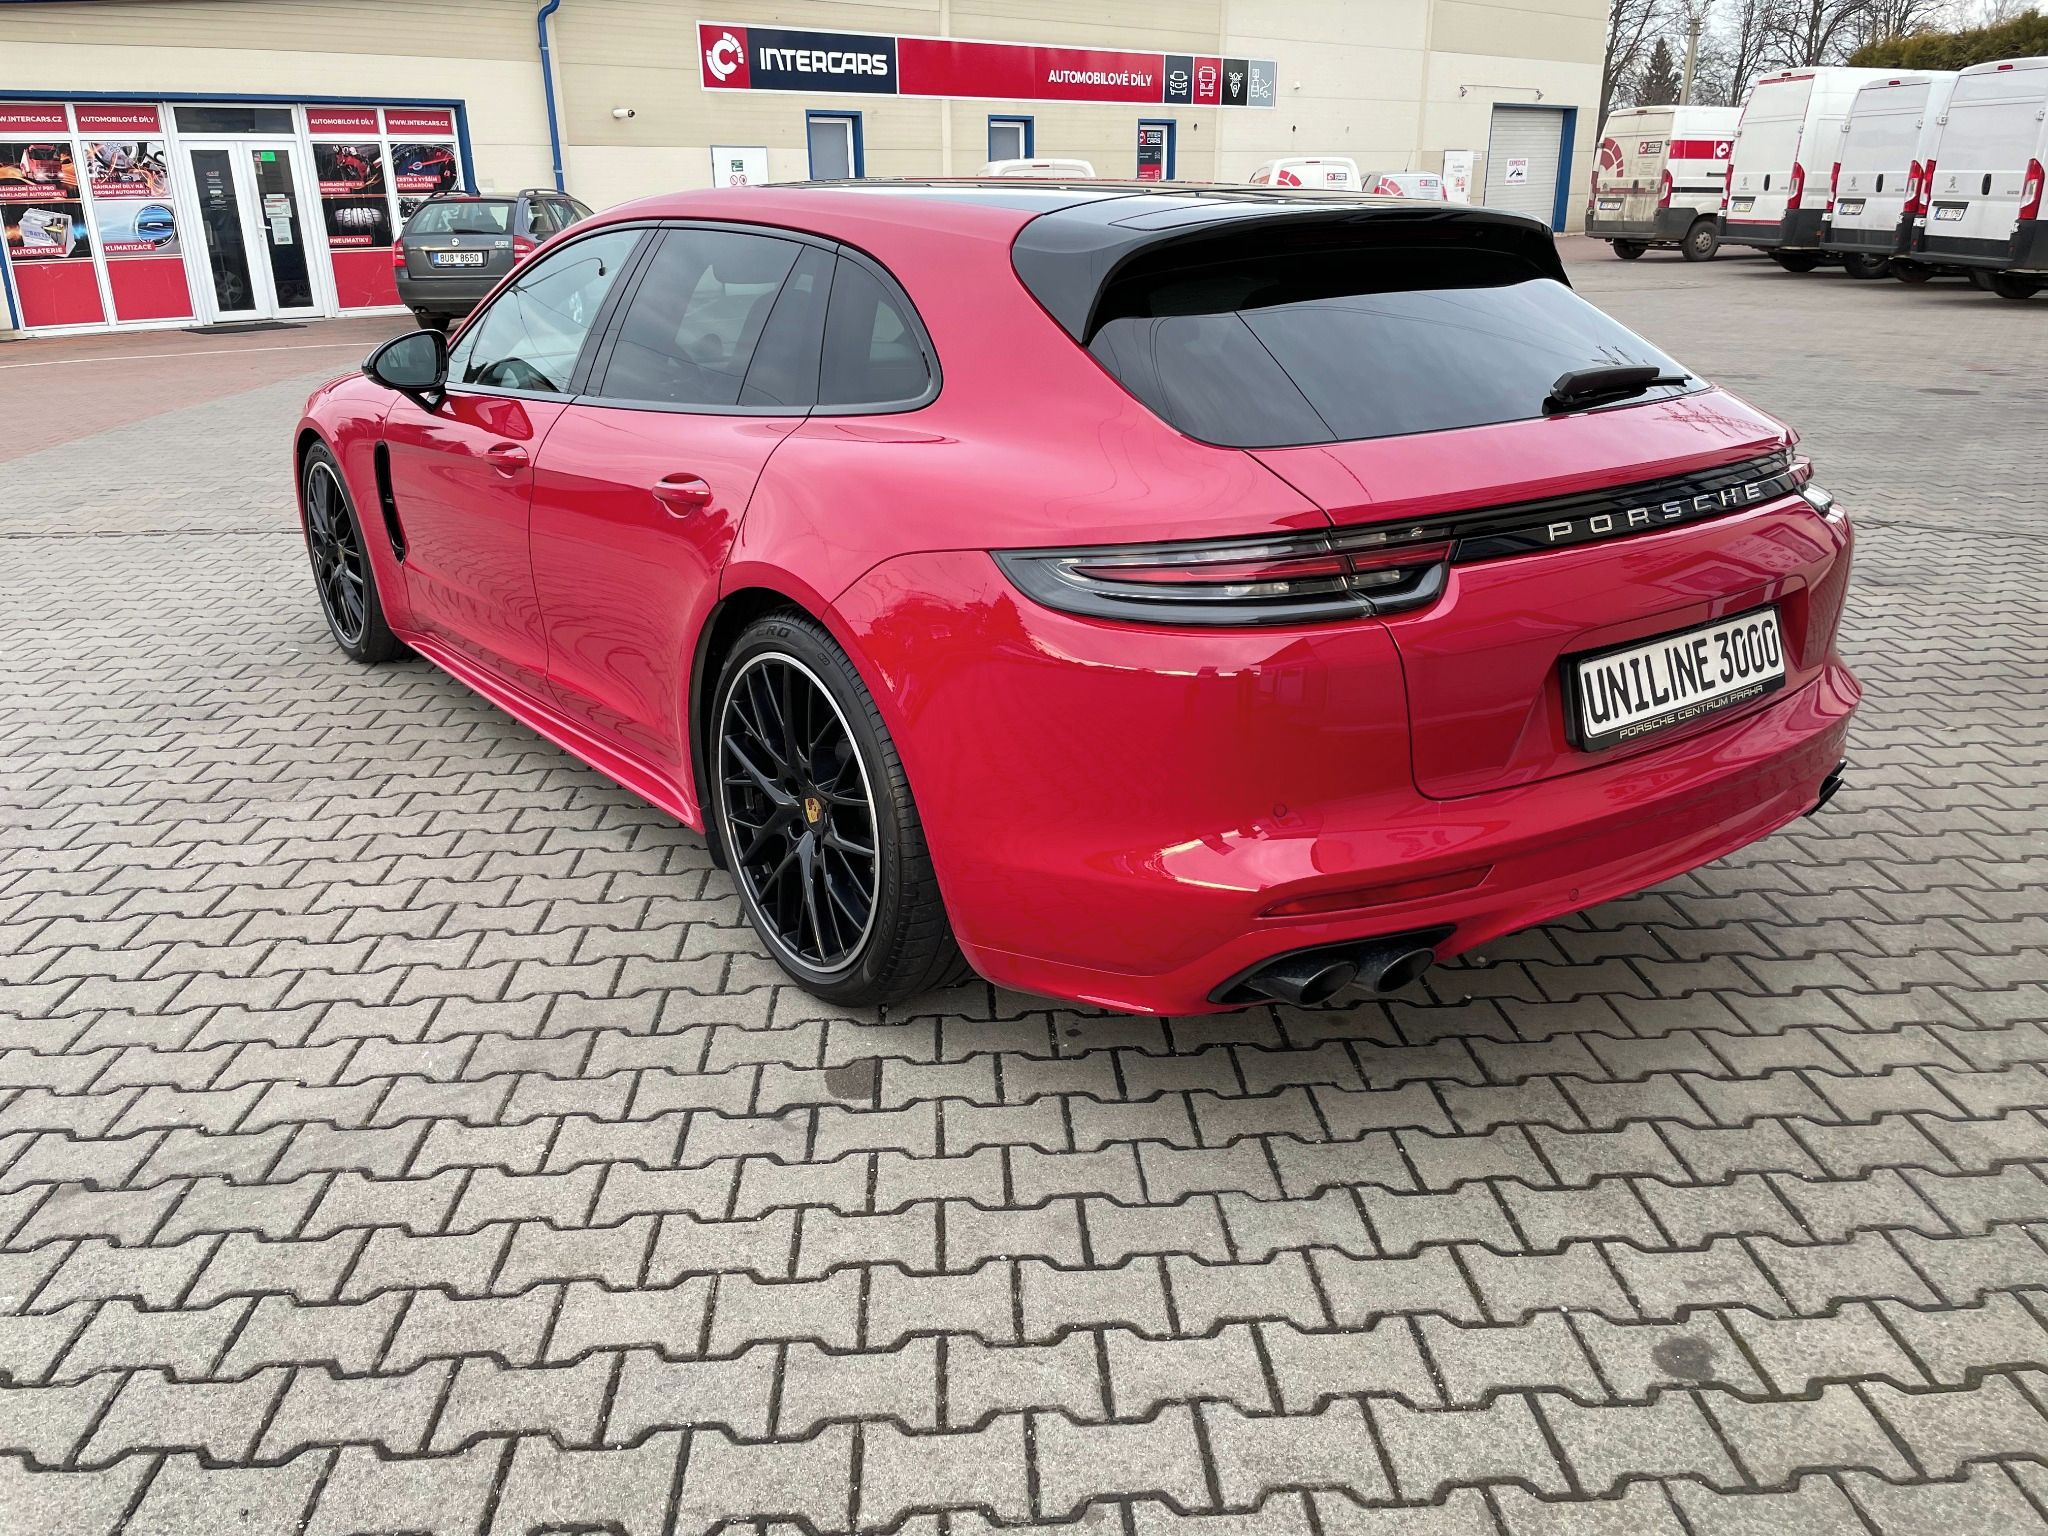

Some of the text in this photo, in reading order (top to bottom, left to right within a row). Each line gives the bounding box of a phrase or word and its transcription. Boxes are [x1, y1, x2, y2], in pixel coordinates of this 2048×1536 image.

[759, 47, 888, 76] INTERCARS
[1048, 69, 1153, 87] AUTOMOBILOVÉ DÍLY
[80, 115, 154, 123] AUTOMOBILOVÉ DÍLY
[310, 117, 374, 125] AUTOMOBILOVÉ DÍLY
[12, 247, 63, 255] AUTOBATERIE
[105, 244, 152, 252] KLIMATIZACE
[1548, 482, 1761, 542] PORSCHE
[1583, 619, 1780, 724] UNILINE 3000
[1619, 684, 1763, 739] PORSCHE CENTRUM PRAHA
